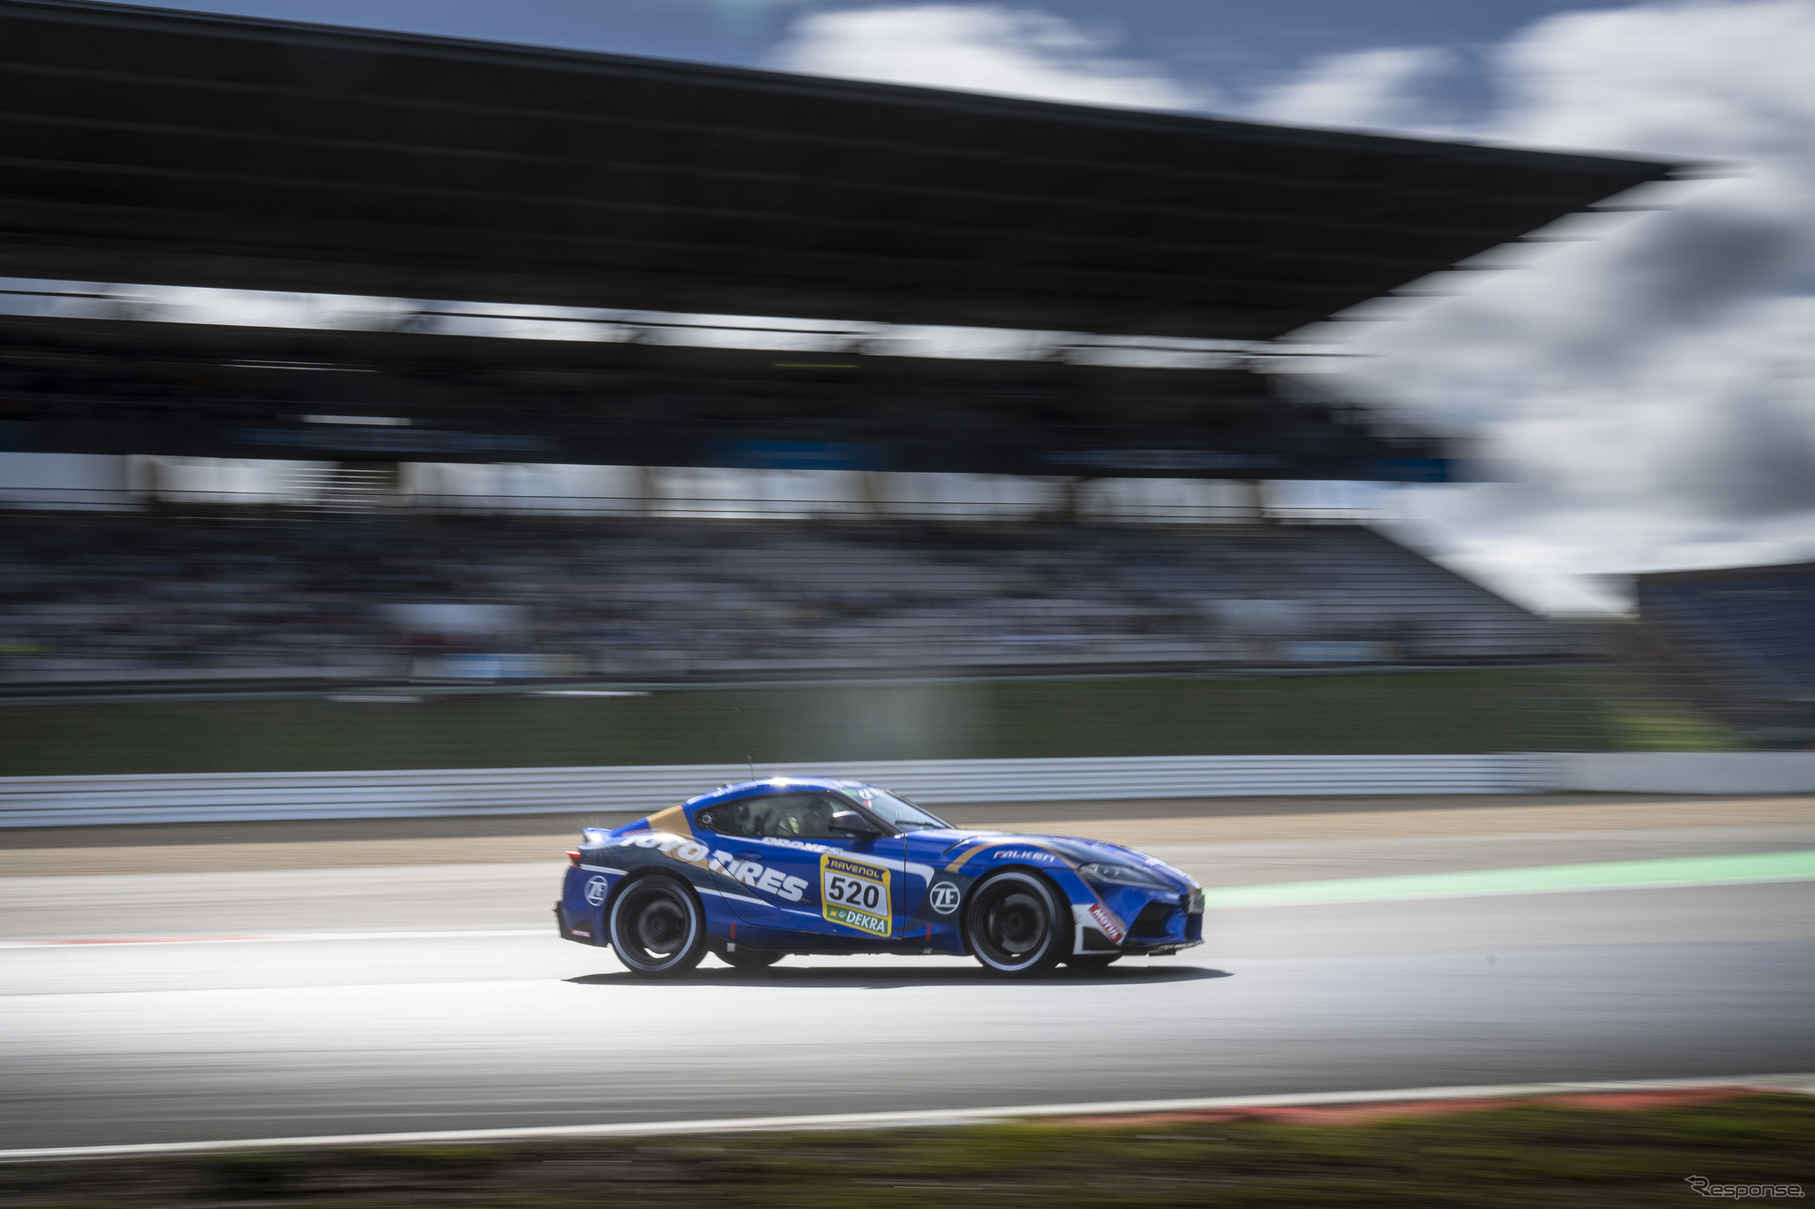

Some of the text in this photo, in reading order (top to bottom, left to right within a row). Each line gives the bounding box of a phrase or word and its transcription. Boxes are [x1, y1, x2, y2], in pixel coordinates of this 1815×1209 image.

[993, 850, 1055, 863] FALKEN
[708, 850, 808, 902] TIRES
[830, 860, 880, 879] RAVENOL
[828, 876, 879, 908] 520
[932, 886, 959, 909] ZF
[846, 910, 885, 933] DEKRA
[1093, 907, 1119, 941] MOTUL
